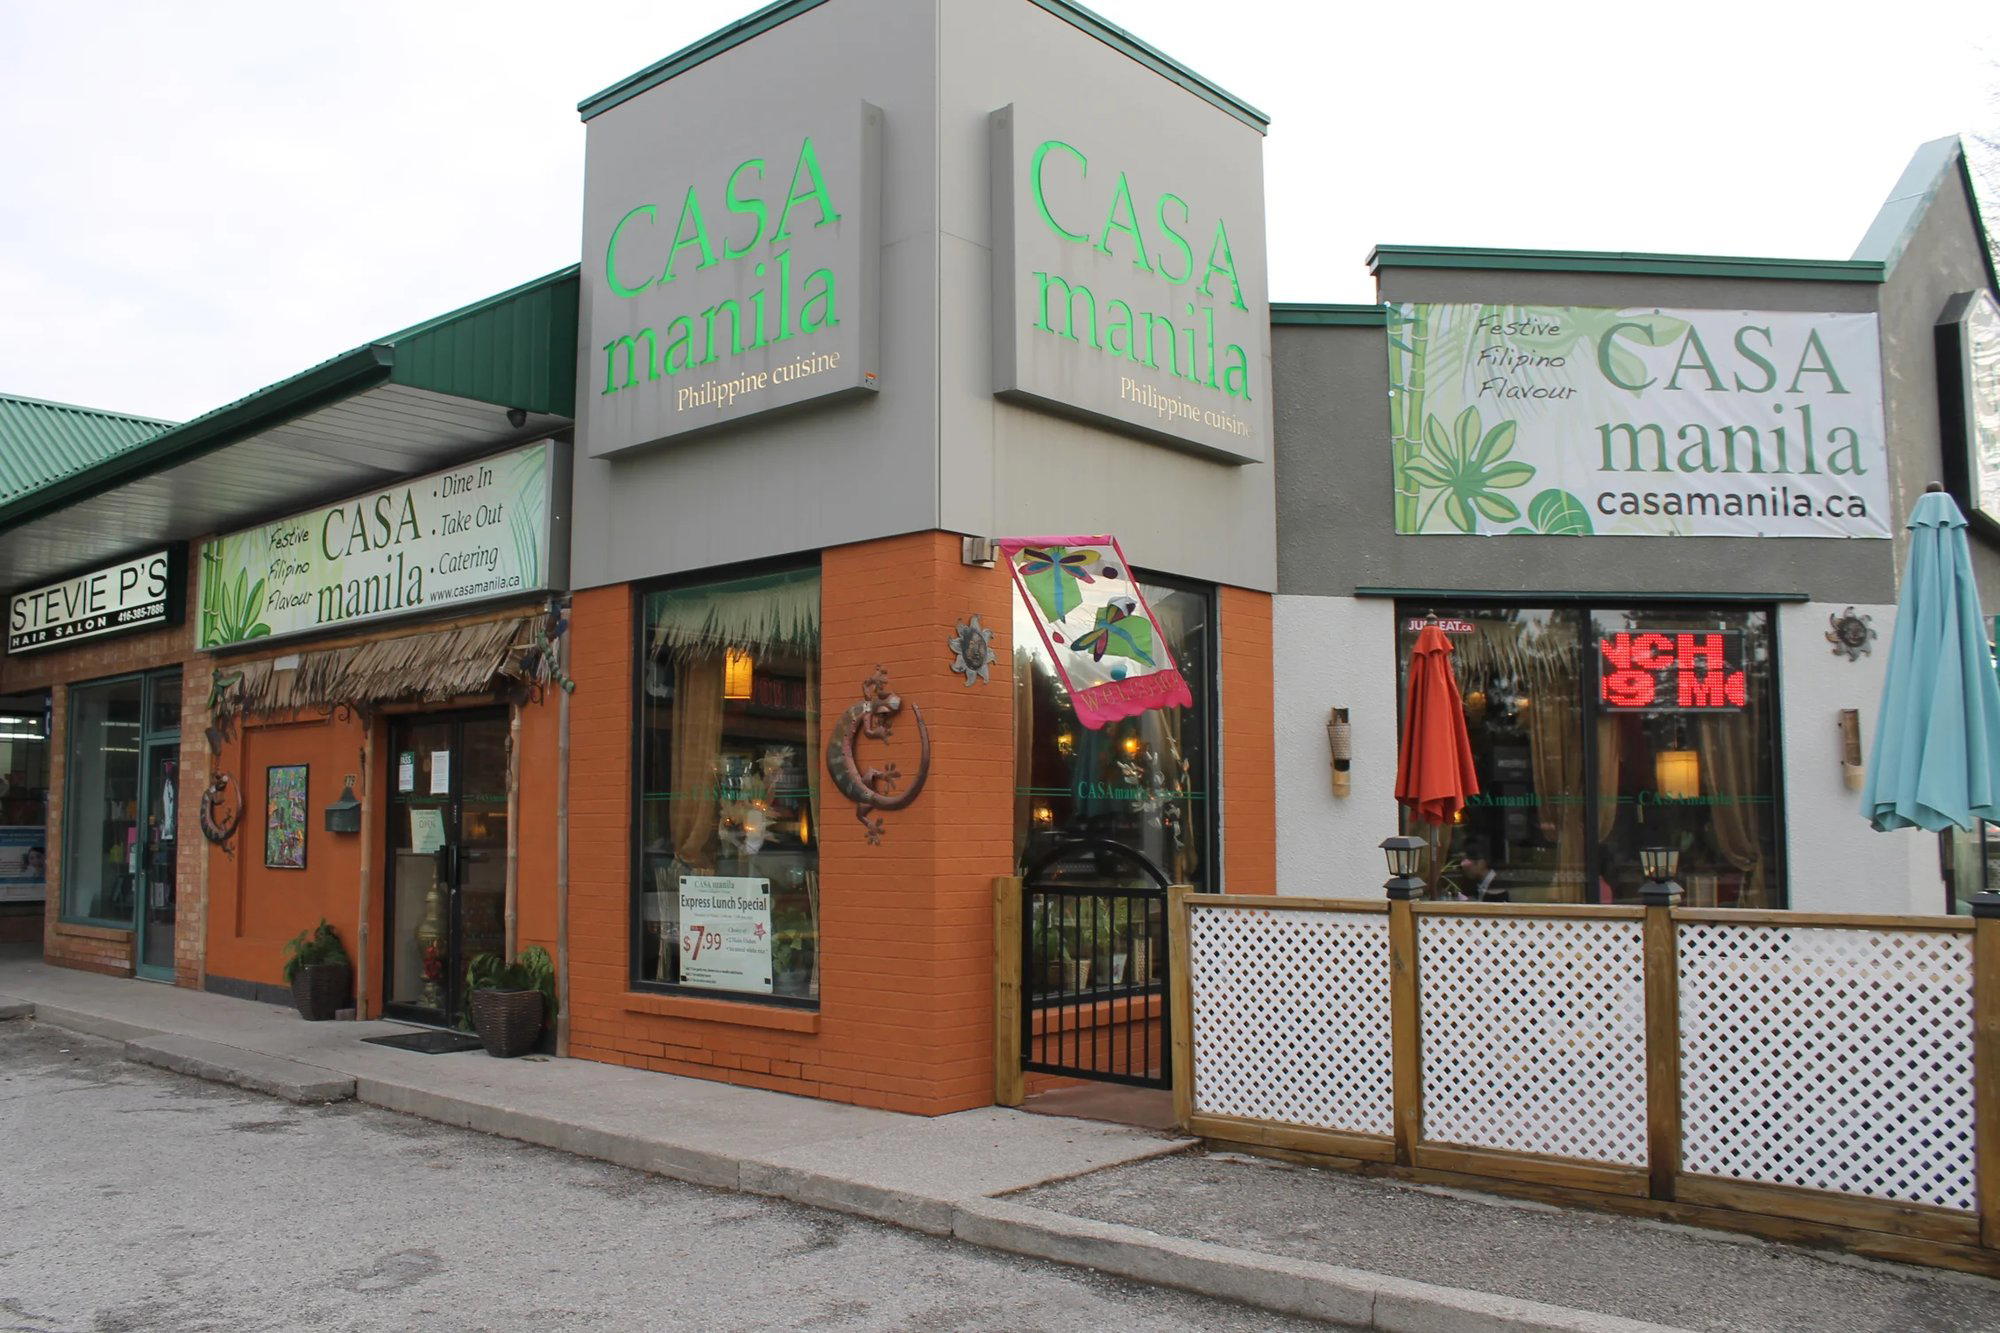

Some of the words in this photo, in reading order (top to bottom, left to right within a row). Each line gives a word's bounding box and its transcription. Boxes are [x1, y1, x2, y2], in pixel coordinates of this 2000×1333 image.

[606, 137, 841, 298] CASA
[1030, 140, 1249, 313] CASA
[601, 248, 841, 396] manila
[1031, 270, 1252, 401] manila
[1475, 314, 1560, 336] Festive
[1477, 345, 1566, 374] Filipino
[1597, 322, 1851, 395] CASA
[677, 371, 768, 412] Philippine
[772, 351, 841, 385] cuisine
[1479, 377, 1577, 399] Flavour
[1121, 377, 1200, 421] Philippine
[1596, 403, 1868, 476] manila
[442, 474, 473, 498] Dine
[477, 466, 493, 488] In
[442, 510, 472, 536] Take
[476, 502, 503, 528] Out
[1596, 486, 1868, 519] casamanila.ca
[269, 527, 309, 551] Festive
[322, 488, 422, 561] CASA
[268, 558, 310, 585] Filipino
[439, 545, 499, 574] Catering
[12, 575, 107, 631] STEVIE
[119, 558, 167, 606] P'S
[266, 589, 312, 612] Flavour
[316, 551, 424, 624] manila
[430, 575, 520, 602] www.casamanila.ca
[12, 631, 46, 647] HAIR
[55, 616, 107, 637] SALON
[1601, 670, 1656, 706] 9
[681, 894, 710, 910] Express
[712, 896, 736, 909] Lunch
[738, 896, 767, 912] Special
[683, 926, 722, 960] $7.99
